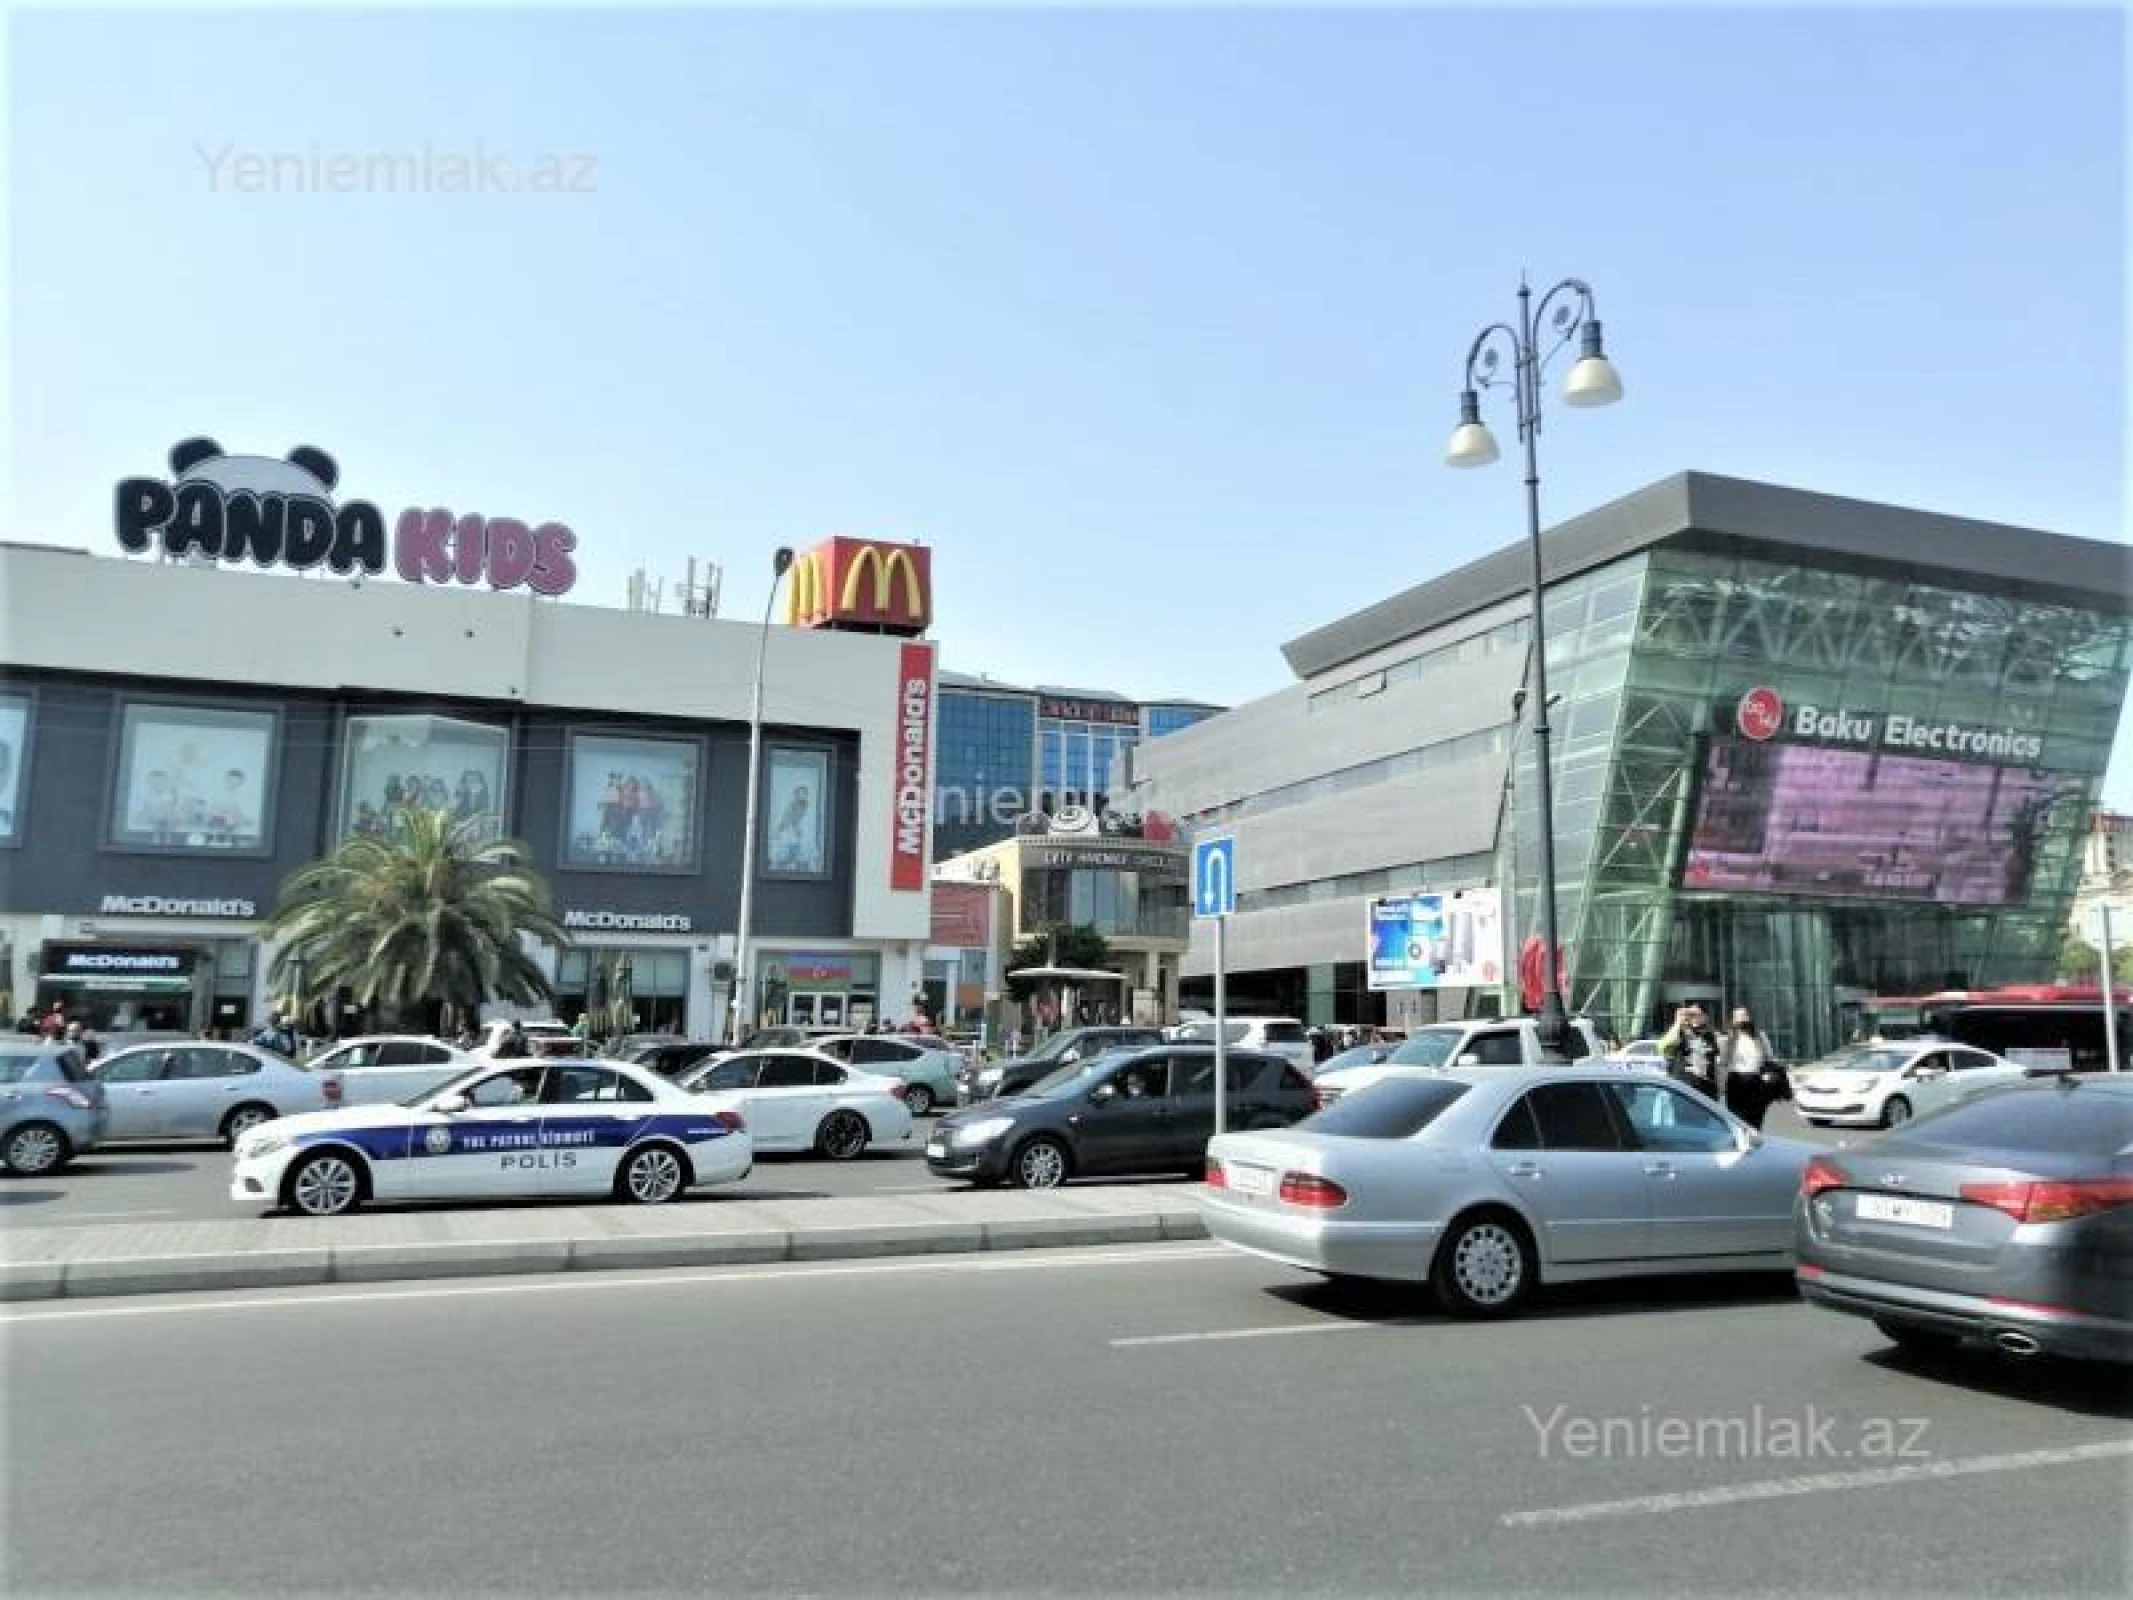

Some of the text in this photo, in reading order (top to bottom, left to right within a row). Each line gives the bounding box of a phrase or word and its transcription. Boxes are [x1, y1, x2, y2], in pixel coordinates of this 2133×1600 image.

[115, 476, 578, 595] PANDA KIDS
[897, 678, 927, 855] McDonald's
[1795, 705, 1873, 741] Baku
[1884, 714, 2042, 758] Electronics
[565, 910, 691, 931] McDonald's
